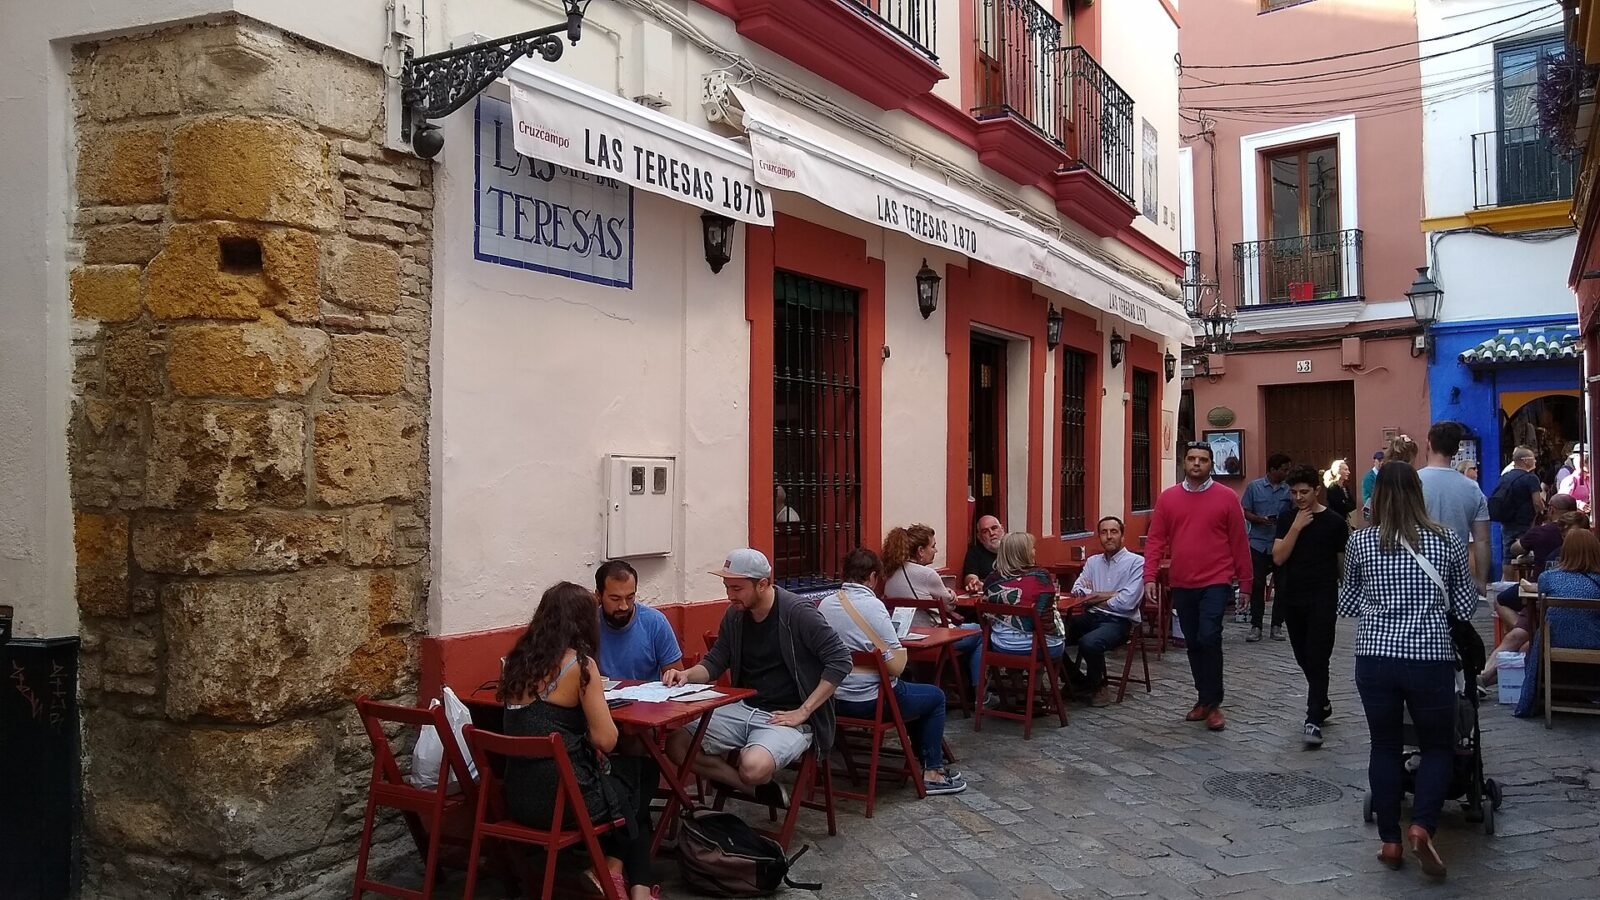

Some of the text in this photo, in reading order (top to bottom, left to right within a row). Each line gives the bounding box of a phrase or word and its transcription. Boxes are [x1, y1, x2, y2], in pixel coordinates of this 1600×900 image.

[518, 120, 570, 149] Cruzcampo
[584, 128, 766, 218] LAS TERESAS 1870
[759, 159, 796, 179] Cruzcampo
[486, 185, 625, 261] TERESAS
[876, 194, 977, 254] LAS TERESAS 1870
